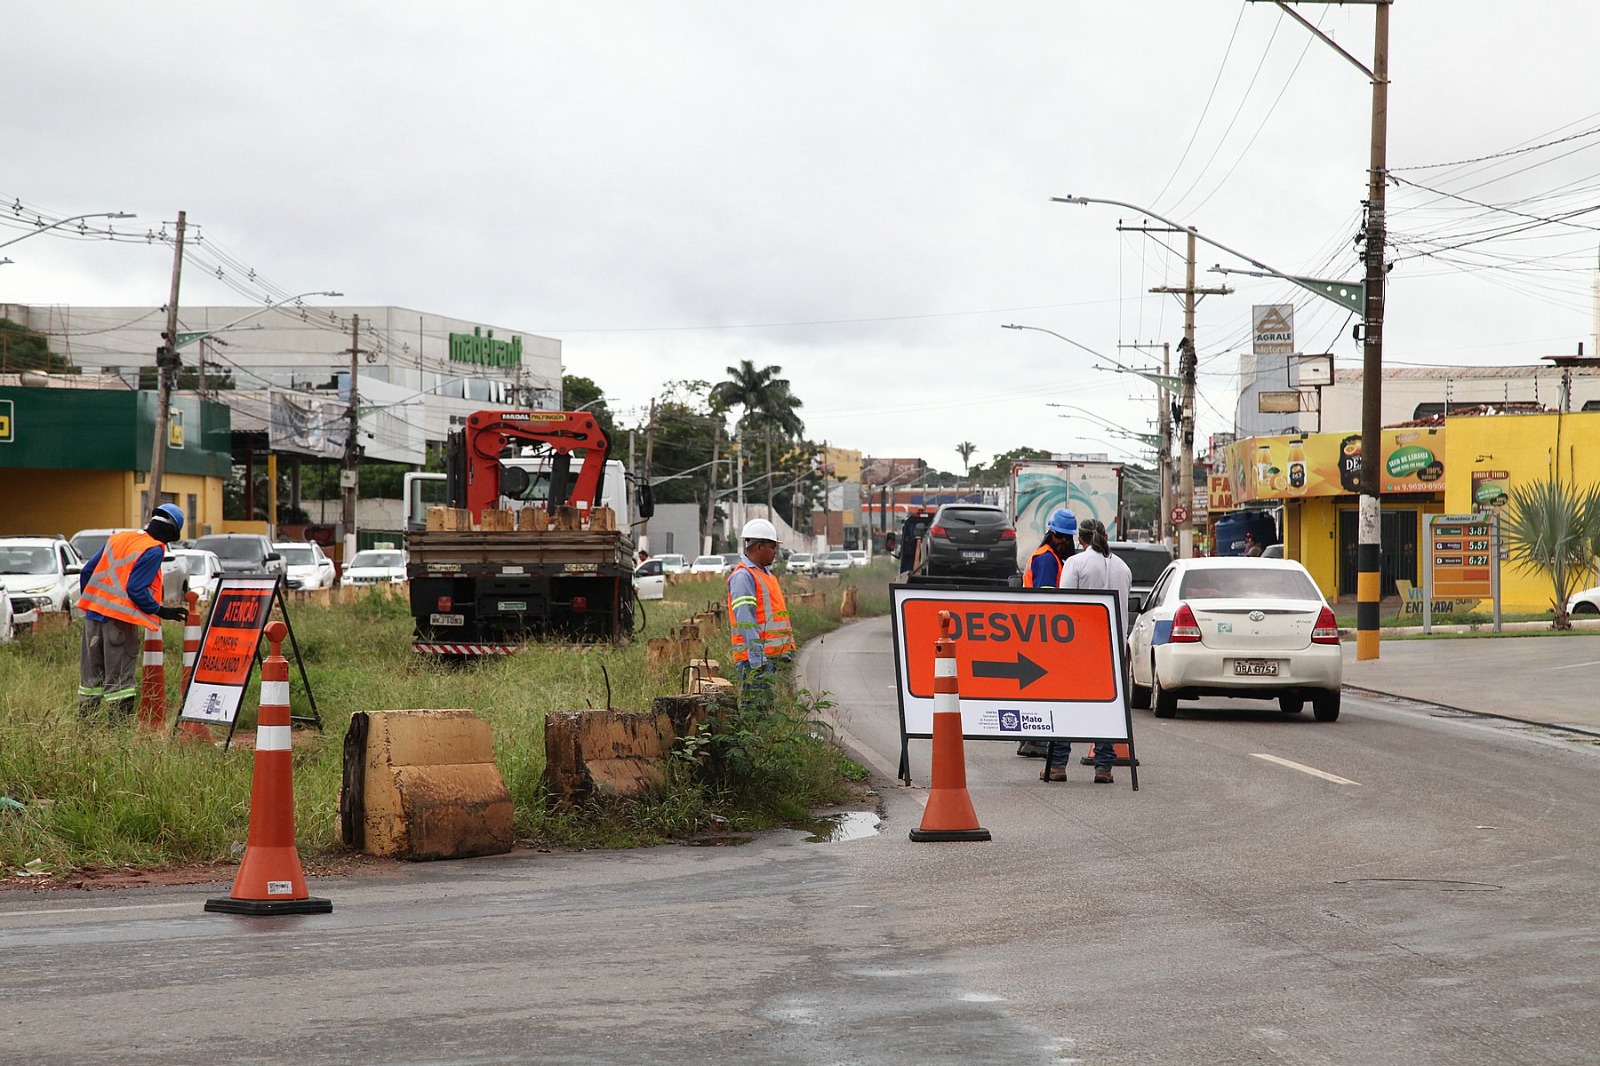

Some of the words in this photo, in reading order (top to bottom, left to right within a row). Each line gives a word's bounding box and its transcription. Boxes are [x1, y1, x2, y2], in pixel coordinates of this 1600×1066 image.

[1256, 333, 1291, 341] AGRALE
[223, 597, 259, 627] ATENÇÃO
[947, 612, 1075, 643] DESVIO
[1022, 723, 1051, 731] Grosso
